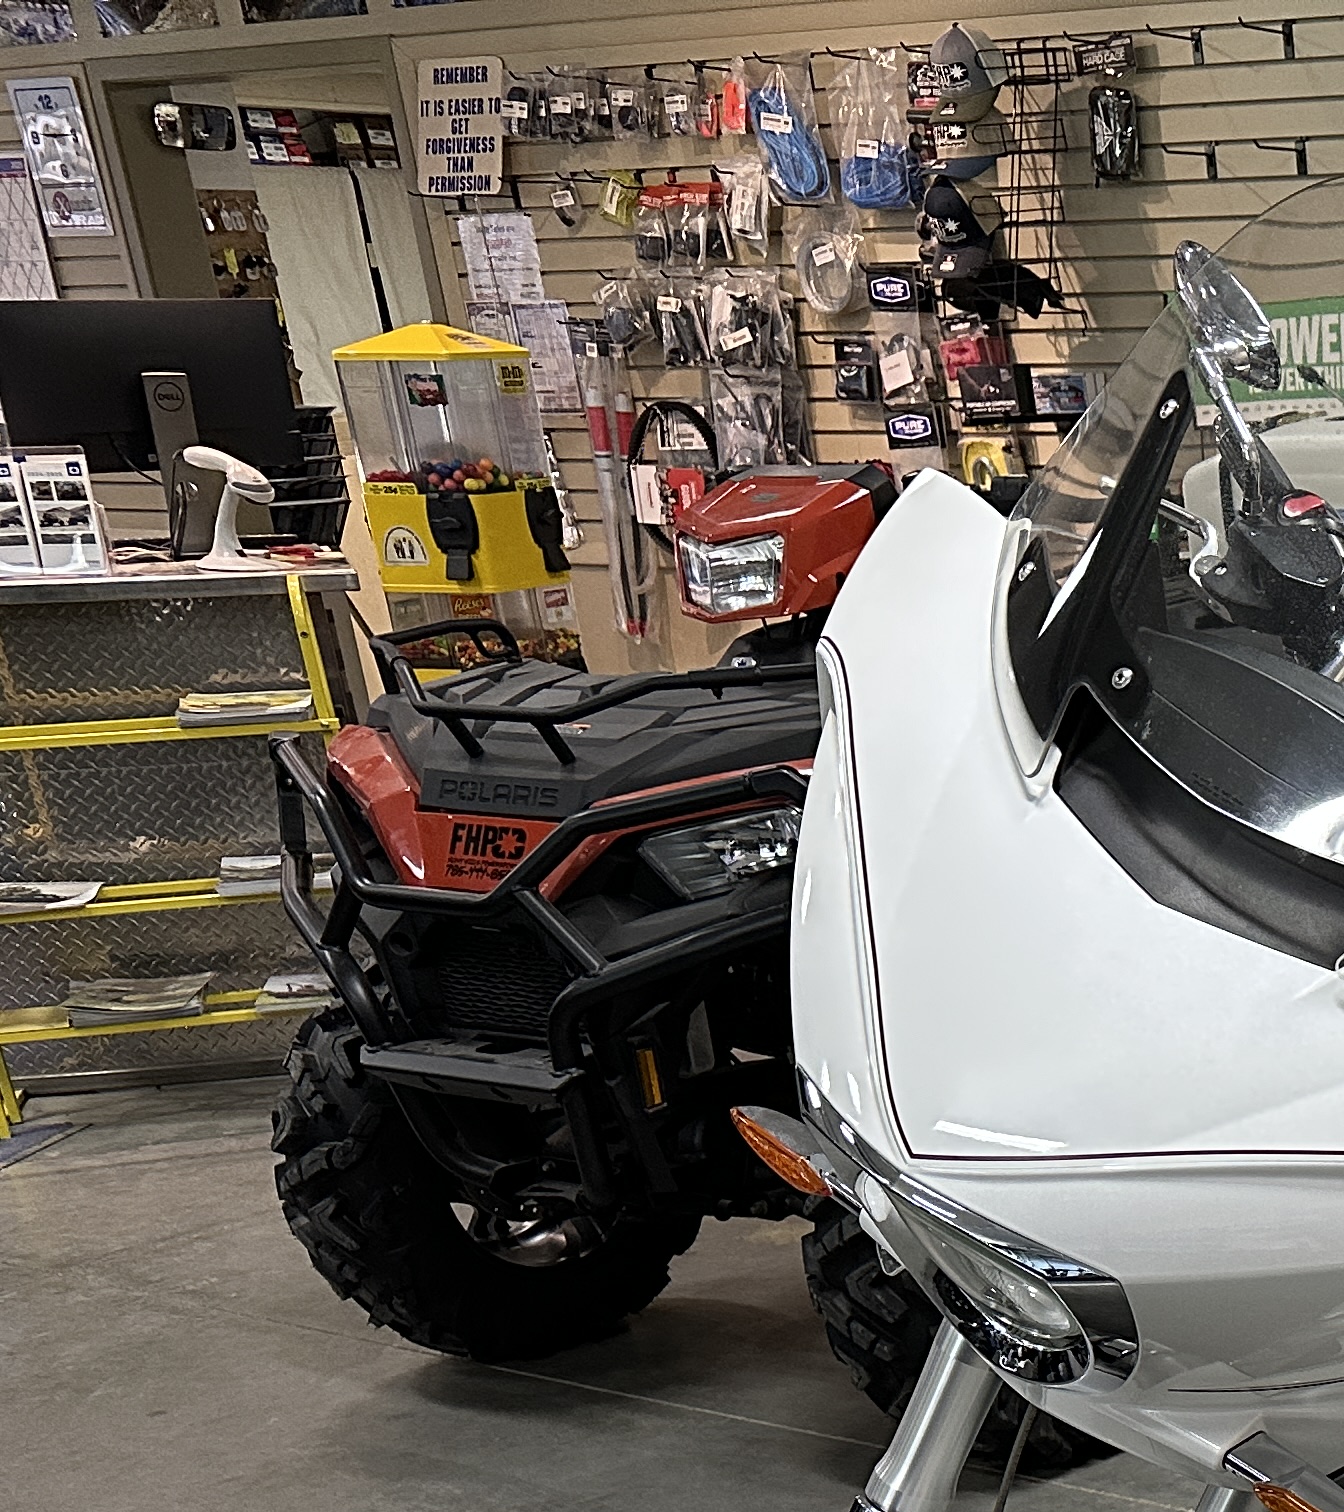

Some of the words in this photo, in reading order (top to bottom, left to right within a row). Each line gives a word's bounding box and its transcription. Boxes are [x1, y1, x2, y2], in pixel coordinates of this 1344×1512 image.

[1083, 53, 1103, 66] HARD
[1104, 50, 1125, 63] CASE
[433, 66, 488, 85] REMEMBER
[38, 94, 53, 109] 12
[421, 100, 430, 117] IT
[433, 100, 444, 117] IS
[448, 98, 484, 116] EASIER
[488, 97, 501, 114] TO
[451, 118, 470, 135] GET
[31, 131, 40, 145] 9
[426, 136, 495, 155] FORGIVENESS
[60, 163, 70, 179] 6
[446, 156, 474, 173] THAN
[428, 175, 491, 193] PERMISSION
[876, 283, 904, 293] PURE
[158, 392, 181, 401] DELL
[895, 420, 925, 430] PURE
[440, 779, 559, 807] POLARIS
